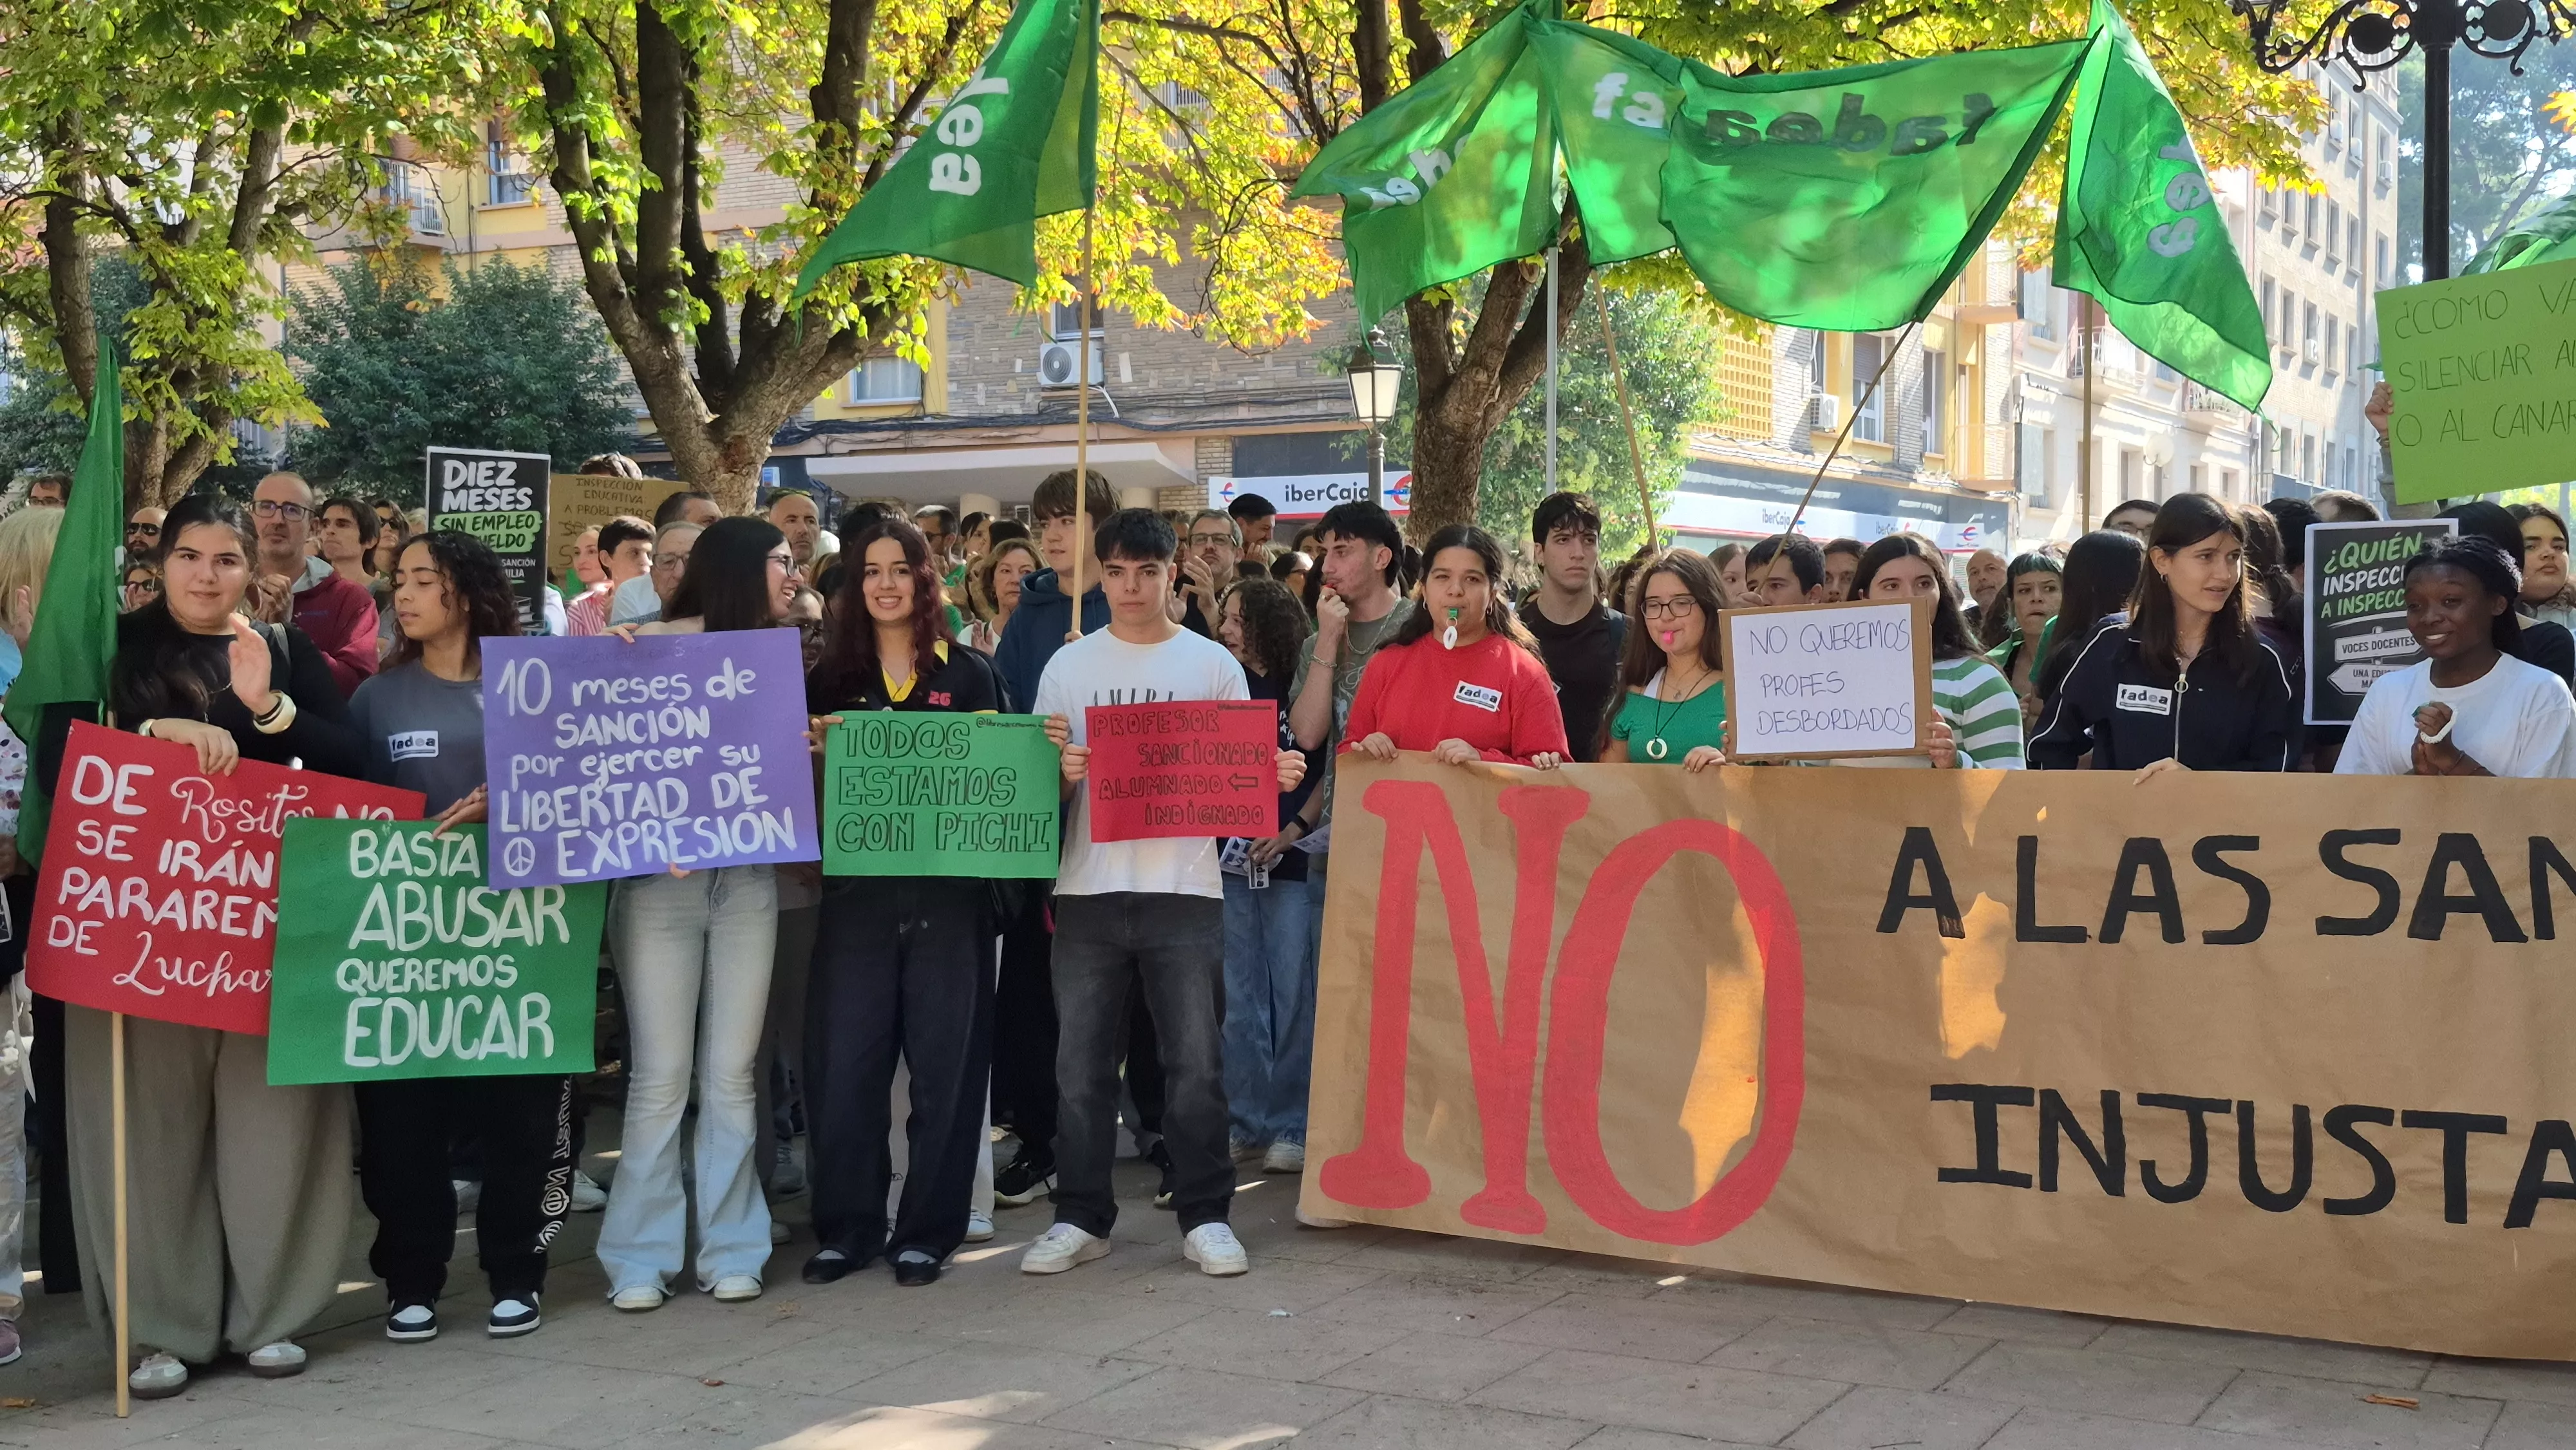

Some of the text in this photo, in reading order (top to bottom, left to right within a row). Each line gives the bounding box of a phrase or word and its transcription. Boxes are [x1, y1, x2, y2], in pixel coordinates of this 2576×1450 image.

[2394, 286, 2508, 339] ¿CÓMO
[2398, 343, 2532, 393] SILENCIAR
[2396, 413, 2422, 447] O
[2439, 409, 2479, 442] AL
[443, 460, 518, 491] DIEZ
[442, 487, 533, 513] MESES
[564, 504, 653, 522] A PROBLEMAS
[584, 489, 643, 504] EDUCATIVA
[440, 514, 535, 532] SIN EMPLEO
[2324, 531, 2421, 574] ¿QUIÉN
[2320, 601, 2331, 618] A
[1750, 618, 1911, 657] NO QUEREMOS
[2342, 636, 2416, 654] VOCES DOCENTES
[497, 657, 757, 716] 10 meses de
[1458, 684, 1498, 703] fadea
[1760, 671, 1845, 698] PROFES
[2353, 669, 2369, 677] UNA
[2120, 688, 2168, 705] fadea
[556, 701, 710, 749] SANCIÓN
[1094, 710, 1220, 737] PROFESOR
[1756, 702, 1913, 735] DESBORDADOS
[390, 732, 437, 751] fadea
[840, 719, 971, 760] TOD@S
[71, 755, 155, 815] DE
[512, 744, 761, 793] por ejercer su
[838, 766, 1016, 806] ESTAMOS
[1099, 775, 1223, 800] ALUMNADO
[500, 767, 769, 834] LIBERTAD DE
[558, 806, 797, 878] EXPRESIÓN
[836, 812, 1052, 853] CON PICHI
[75, 820, 274, 888] SE IRÁN
[351, 829, 480, 878] BASTA
[1876, 827, 1965, 939] A
[2016, 835, 2271, 945] LAS
[48, 915, 105, 956] DE
[348, 881, 570, 952] ABUSAR
[337, 954, 518, 997] QUEREMOS
[345, 992, 554, 1068] EDUCAR
[1319, 779, 1806, 1247] NO
[1930, 1084, 2576, 1230] INJUSTA
